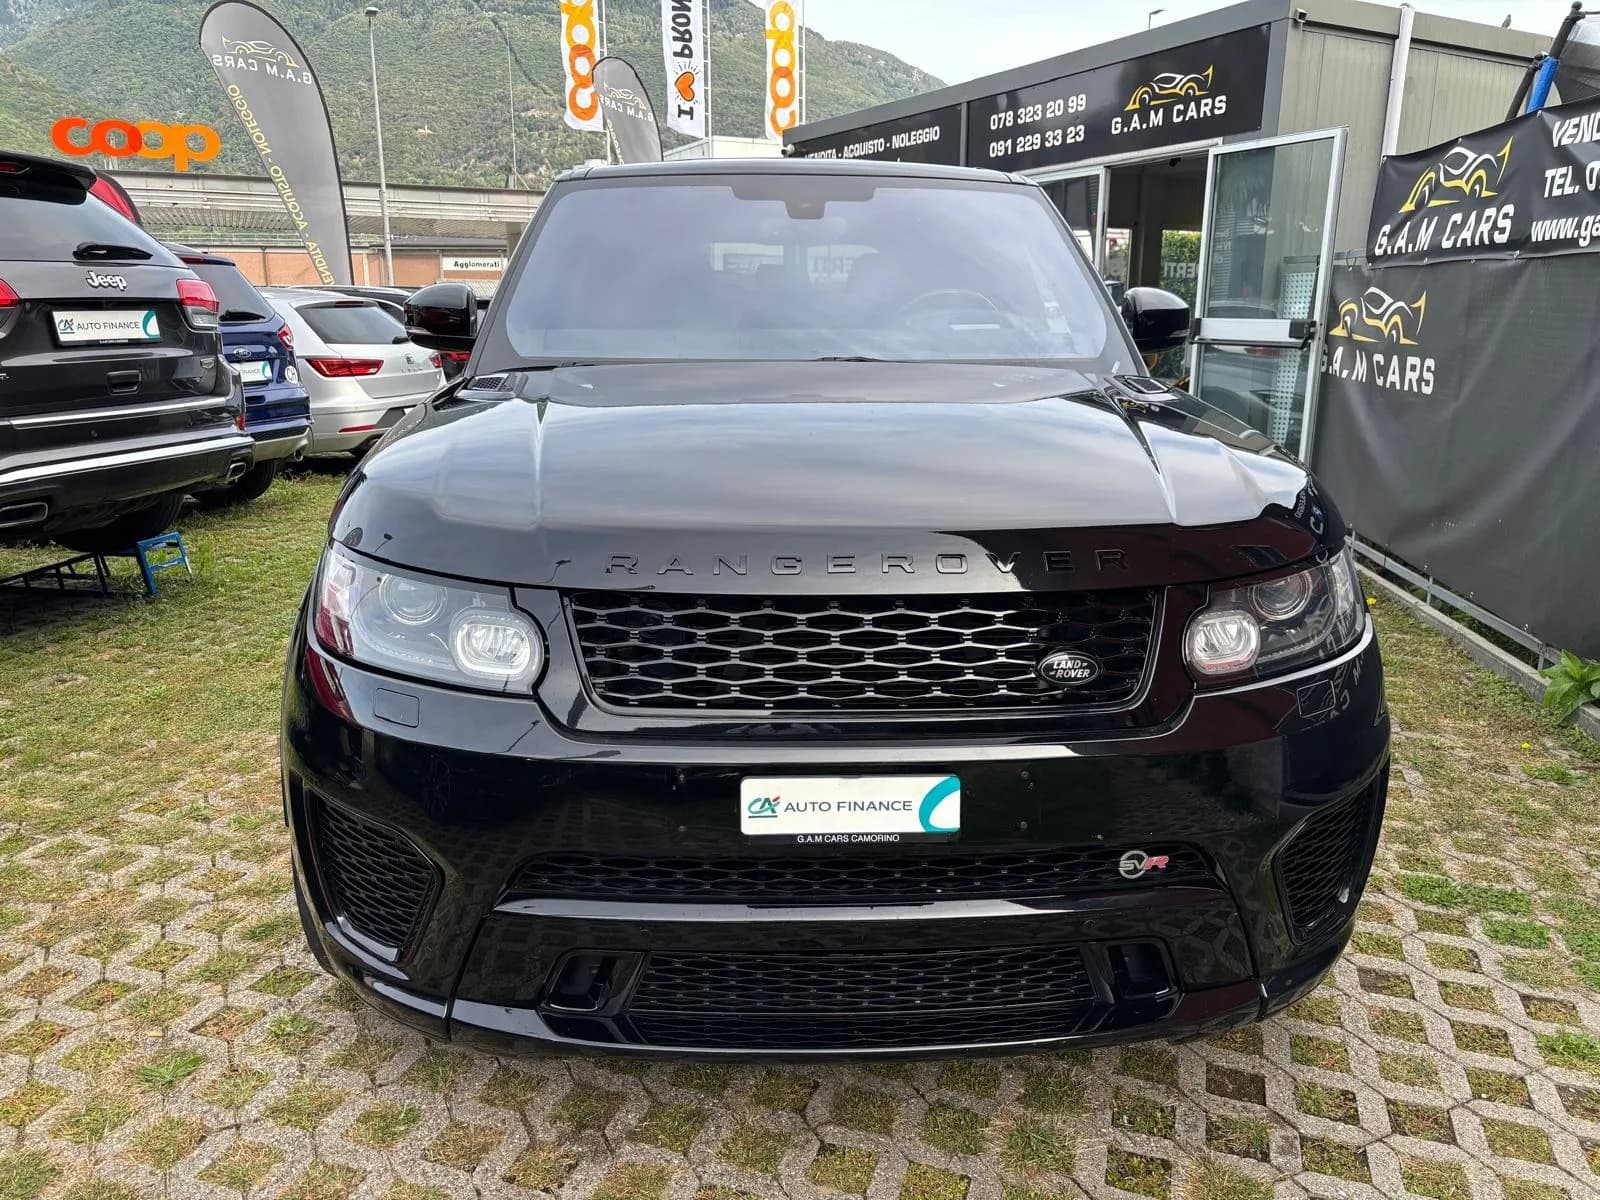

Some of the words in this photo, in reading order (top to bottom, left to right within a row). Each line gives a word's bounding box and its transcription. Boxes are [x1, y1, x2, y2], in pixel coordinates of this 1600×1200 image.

[990, 112, 1014, 131] 078
[1017, 104, 1042, 124] 323
[1046, 98, 1064, 118] 20
[1067, 93, 1087, 113] 99
[1111, 107, 1164, 135] G.A.M
[1172, 95, 1227, 123] CARS
[50, 115, 222, 173] coop
[843, 137, 885, 159] ACQUISTO
[892, 125, 941, 149] NOLEGGIO
[989, 138, 1012, 158] 091
[1016, 133, 1041, 153] 229
[1044, 129, 1063, 148] 33
[1066, 124, 1086, 143] 23
[1543, 165, 1580, 198] TEL.
[1374, 215, 1438, 256] G.A.M
[1441, 204, 1515, 249] CARS
[454, 260, 500, 268] Agglomerati
[86, 271, 127, 291] Jeep
[77, 320, 101, 330] AUTO
[103, 321, 140, 330] FINANCE
[1372, 353, 1436, 395] CARS
[1053, 659, 1082, 669] LAND
[1055, 669, 1090, 678] ROVER
[784, 801, 832, 813] AUTO
[837, 800, 913, 812] FINANCE
[797, 834, 823, 843] G.A.M
[824, 834, 849, 843] CARS
[851, 834, 900, 843] CAMORINO
[1119, 852, 1169, 877] SVR
